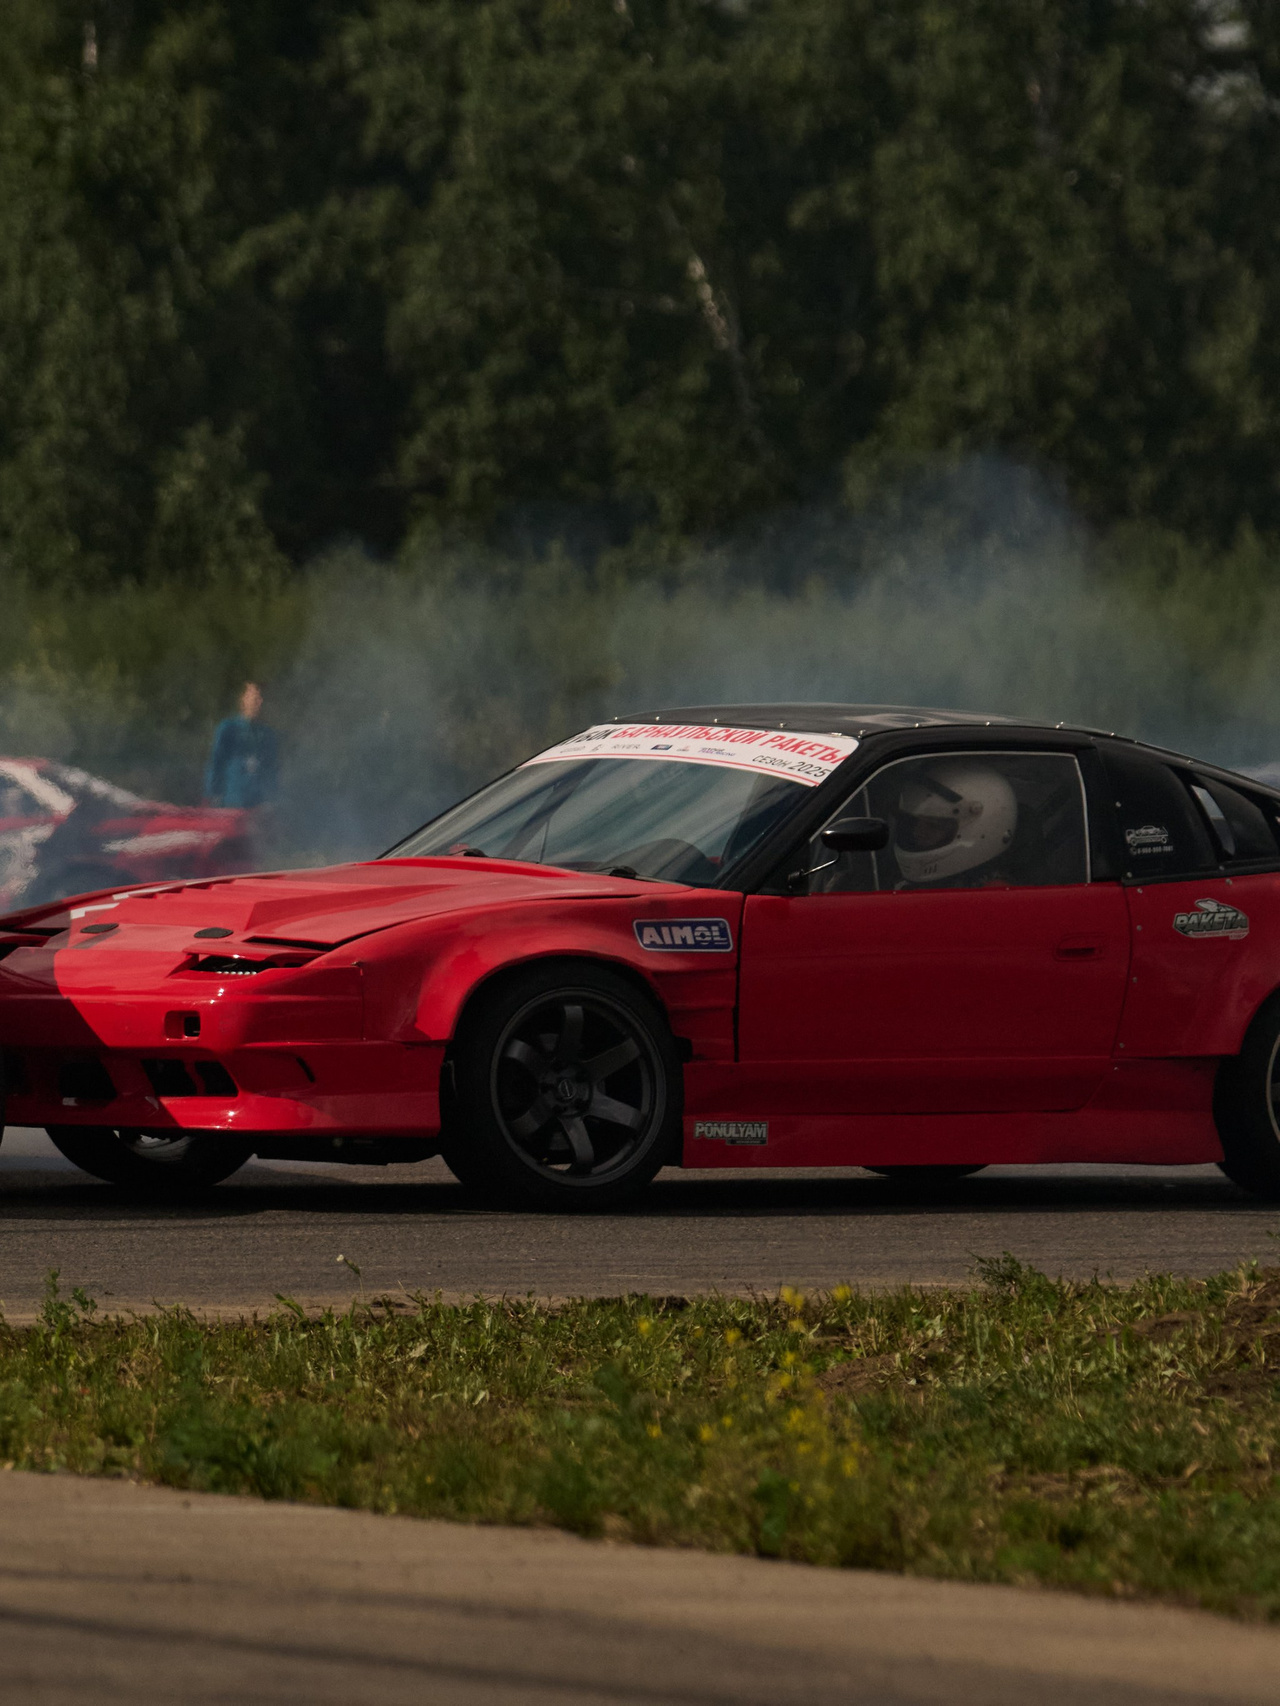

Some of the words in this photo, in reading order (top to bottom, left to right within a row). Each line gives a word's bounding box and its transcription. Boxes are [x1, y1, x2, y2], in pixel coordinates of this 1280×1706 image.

[611, 725, 772, 746] БАРНАУЛЬСКОЙ
[752, 754, 792, 768] СЕЗОН
[788, 760, 832, 778] 2025
[642, 926, 728, 945] AIMOL
